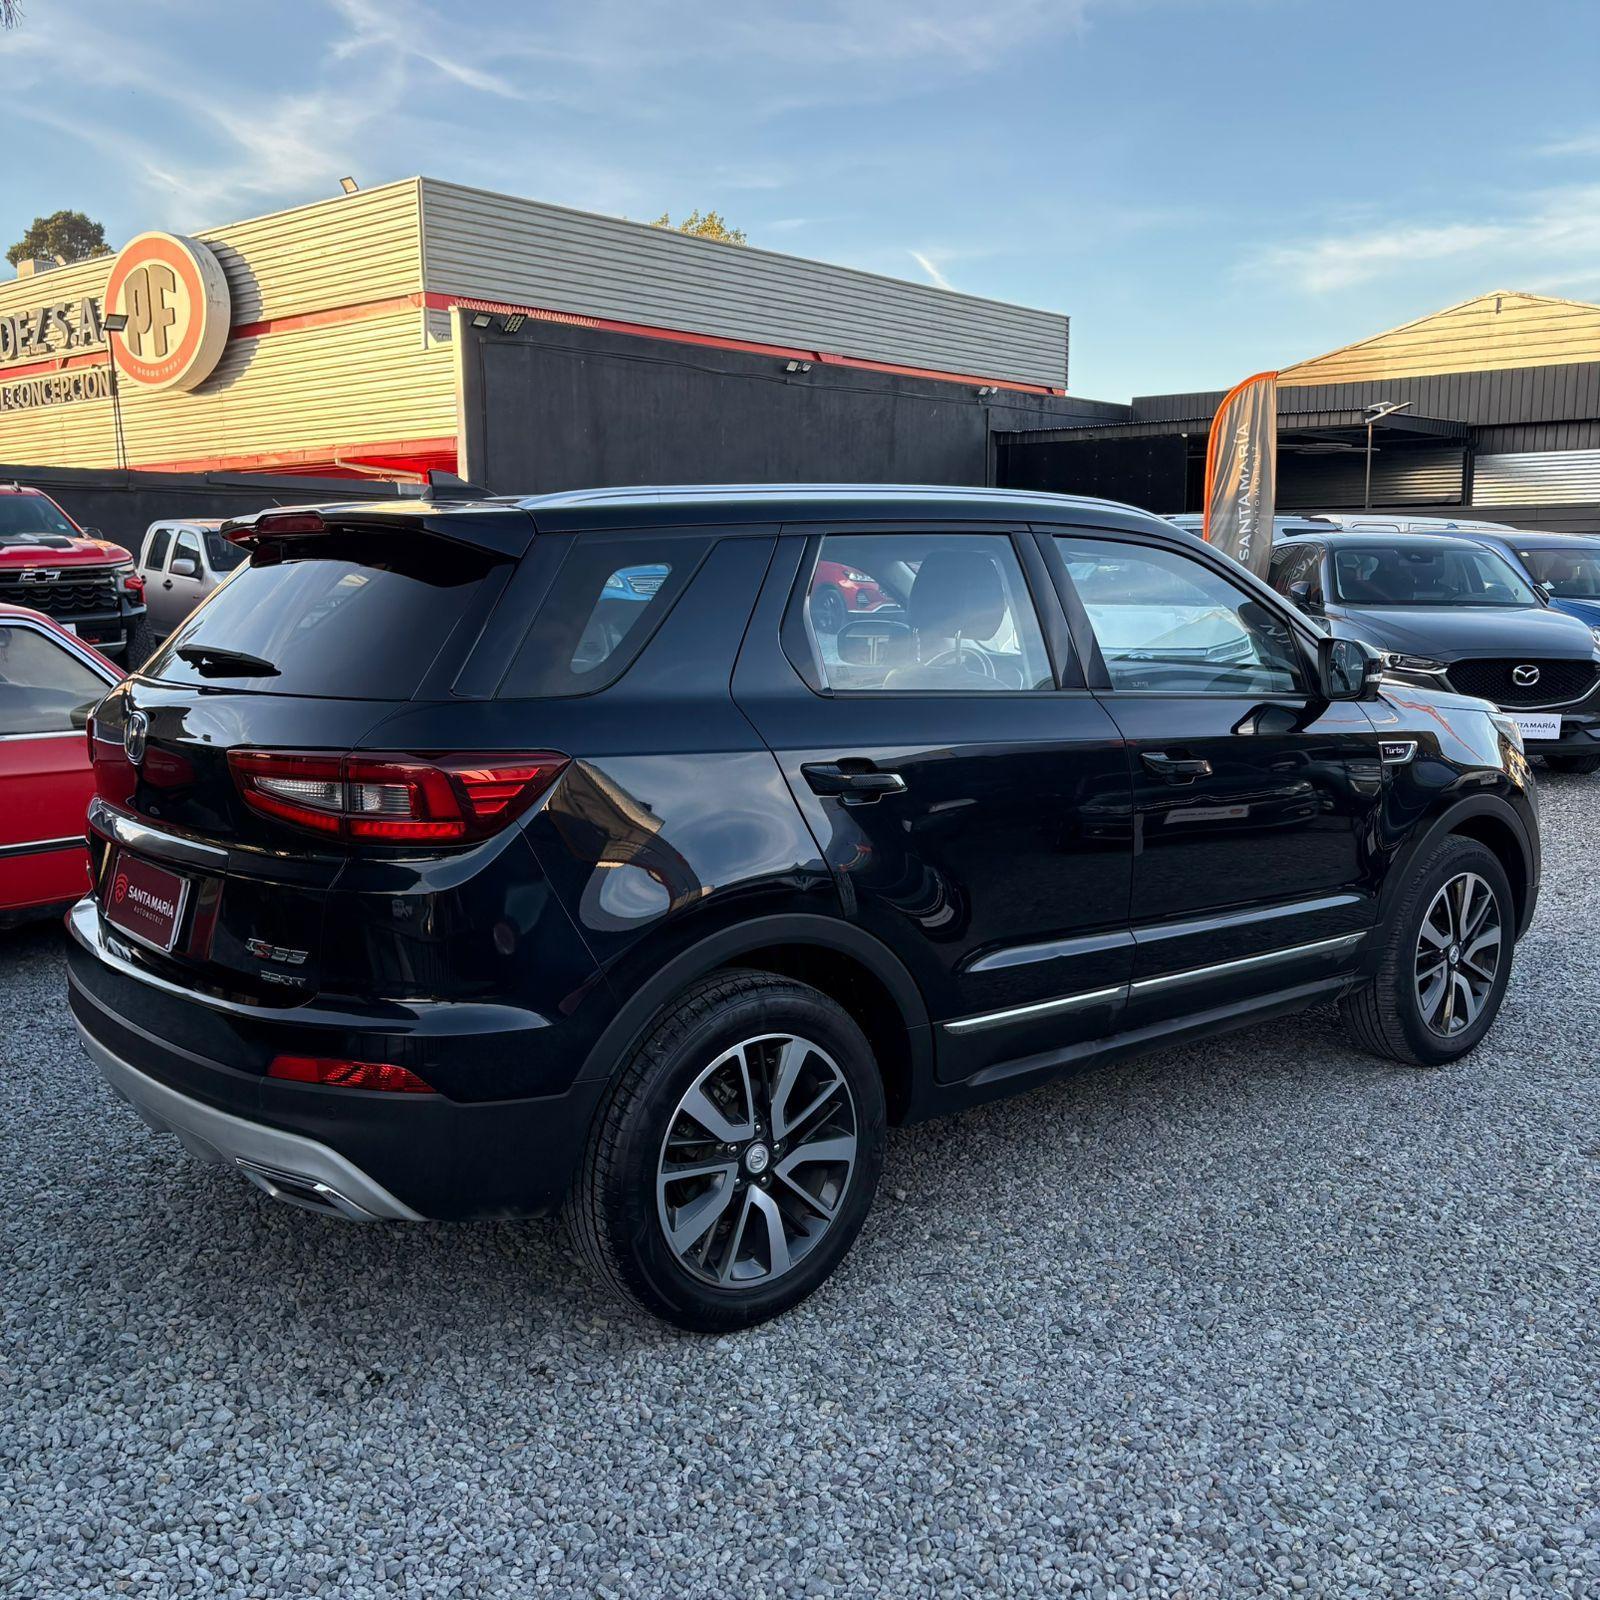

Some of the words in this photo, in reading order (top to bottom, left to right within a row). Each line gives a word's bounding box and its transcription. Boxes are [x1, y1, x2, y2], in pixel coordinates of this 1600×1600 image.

[1233, 422, 1251, 562] SANTAMARÍA
[1385, 746, 1405, 754] Turbo
[128, 885, 174, 919] SANTAMARÍA
